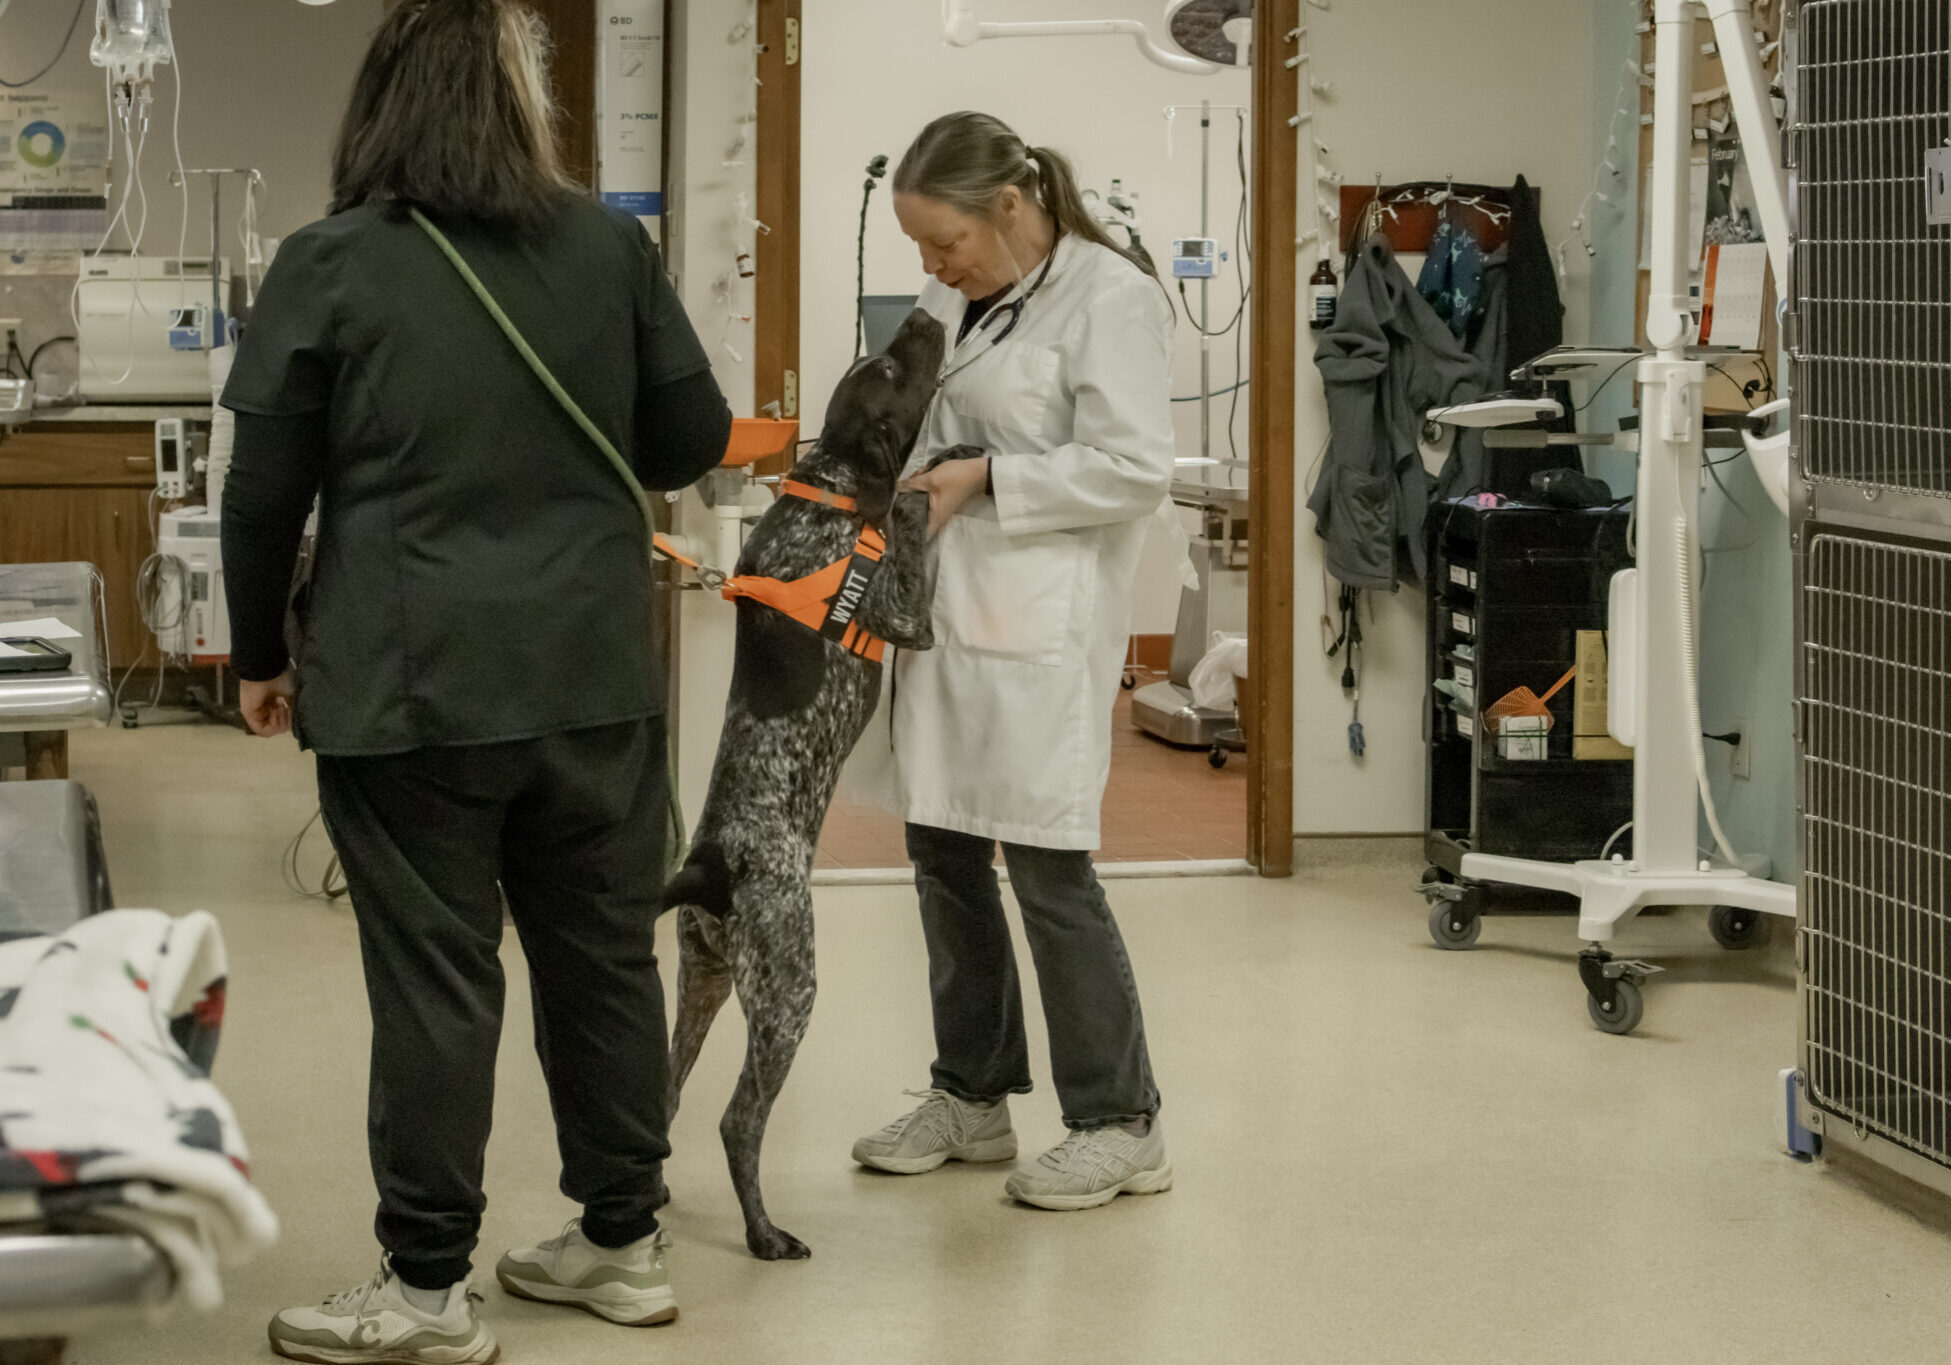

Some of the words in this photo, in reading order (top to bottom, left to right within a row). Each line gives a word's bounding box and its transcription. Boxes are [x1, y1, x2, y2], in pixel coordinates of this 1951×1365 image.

[620, 16, 633, 25] BD
[1711, 148, 1738, 162] February
[830, 569, 869, 624] WYATT
